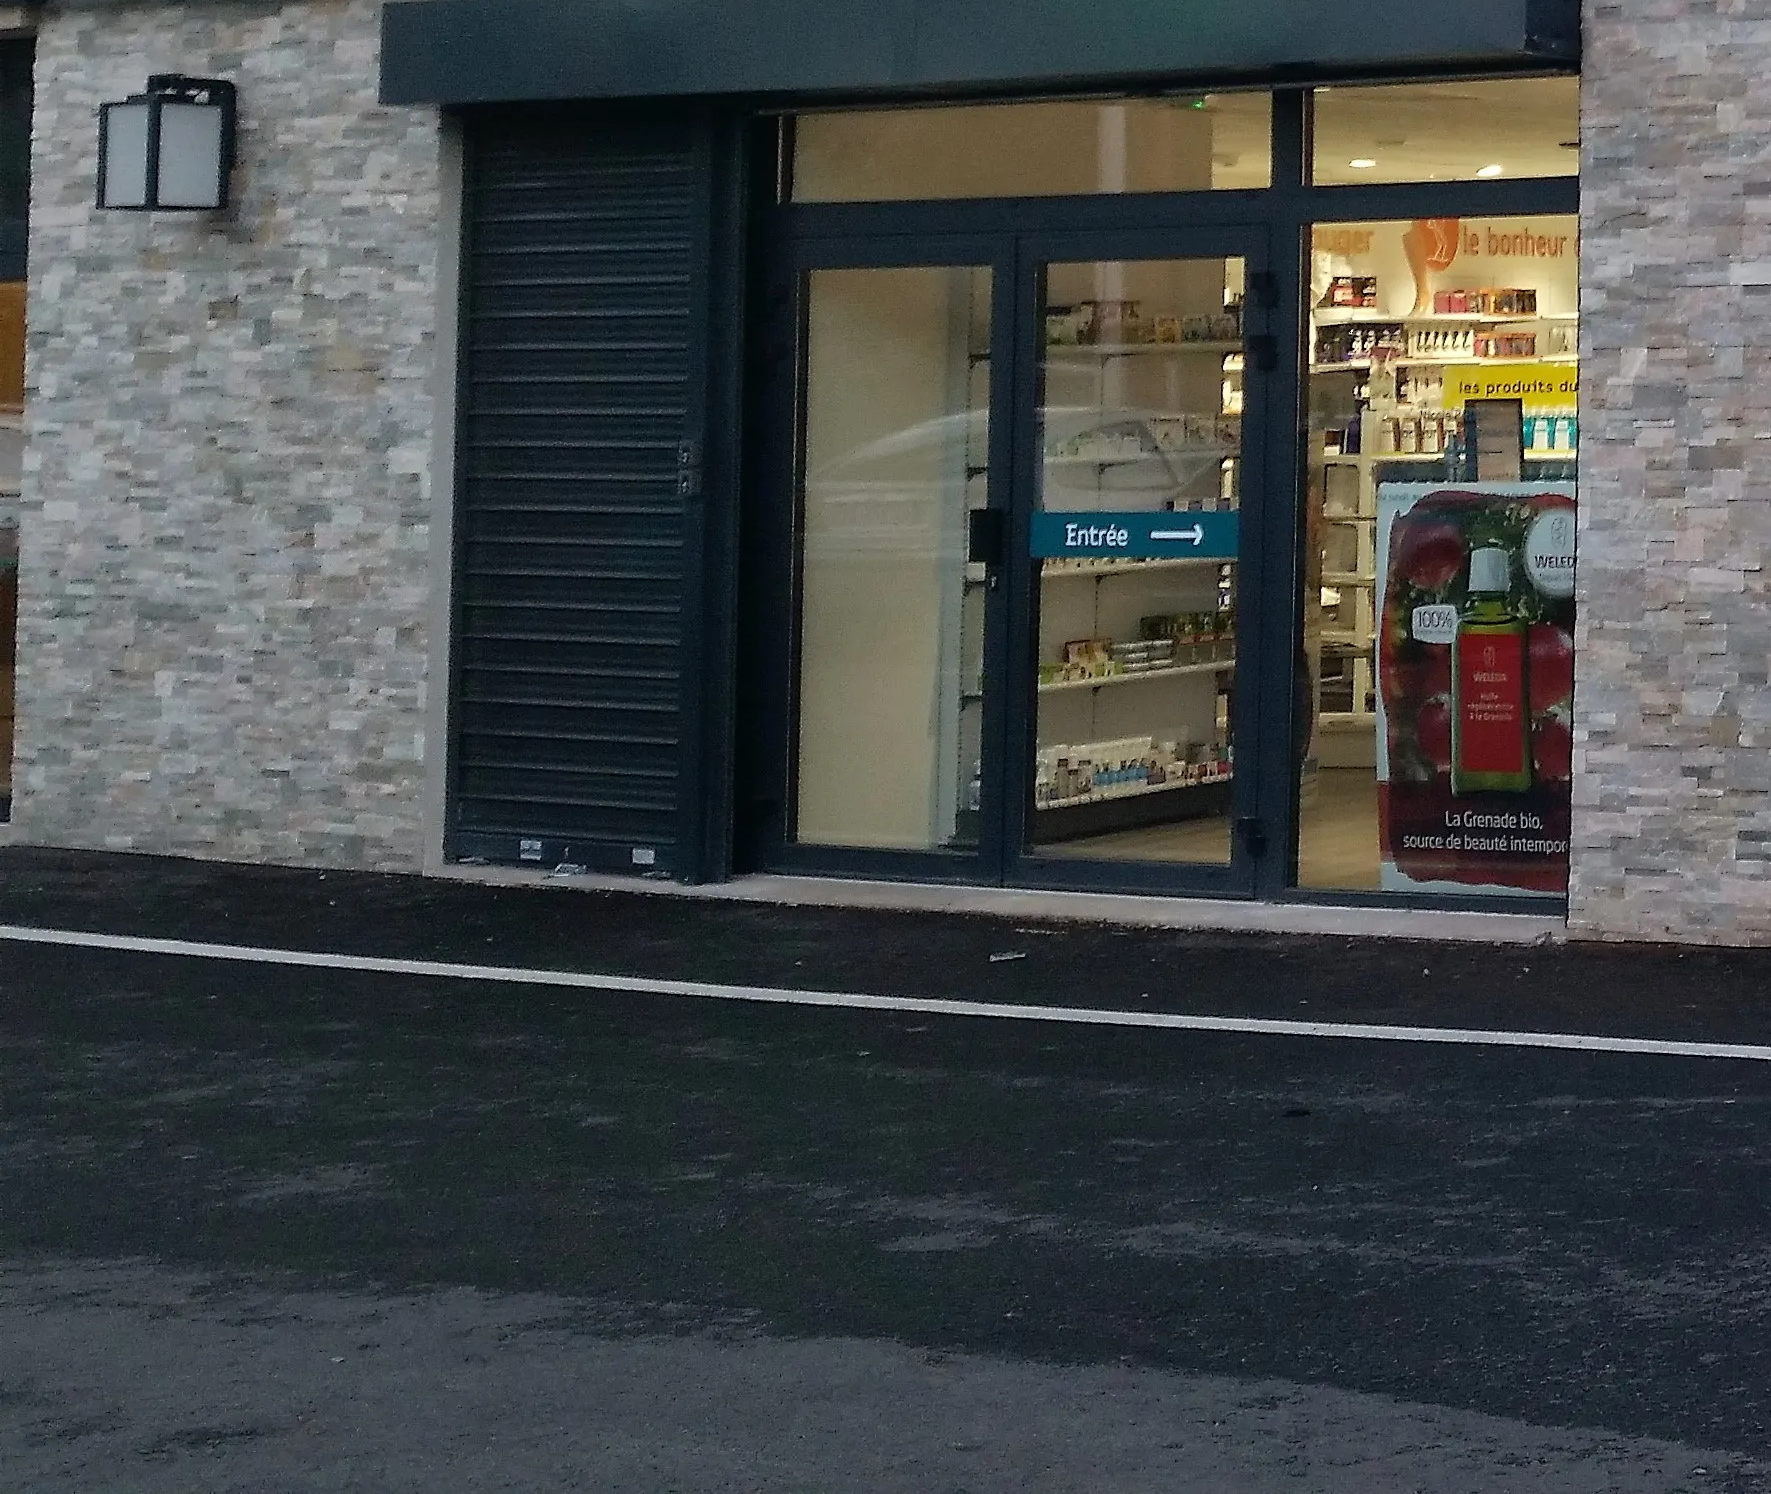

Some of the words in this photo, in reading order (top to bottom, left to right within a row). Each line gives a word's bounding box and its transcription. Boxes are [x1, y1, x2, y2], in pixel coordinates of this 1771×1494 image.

[1464, 225, 1479, 254] le
[1488, 226, 1566, 258] bonheur
[1459, 381, 1479, 394] les
[1486, 379, 1553, 396] produits
[1559, 380, 1578, 393] du
[1065, 523, 1129, 547] Entrée
[1417, 611, 1453, 628] 100%
[1445, 810, 1460, 827] La
[1464, 811, 1517, 829] Grenade
[1520, 812, 1543, 830] bio,
[1403, 835, 1443, 849] source
[1446, 834, 1461, 849] de
[1464, 834, 1507, 851] beauté
